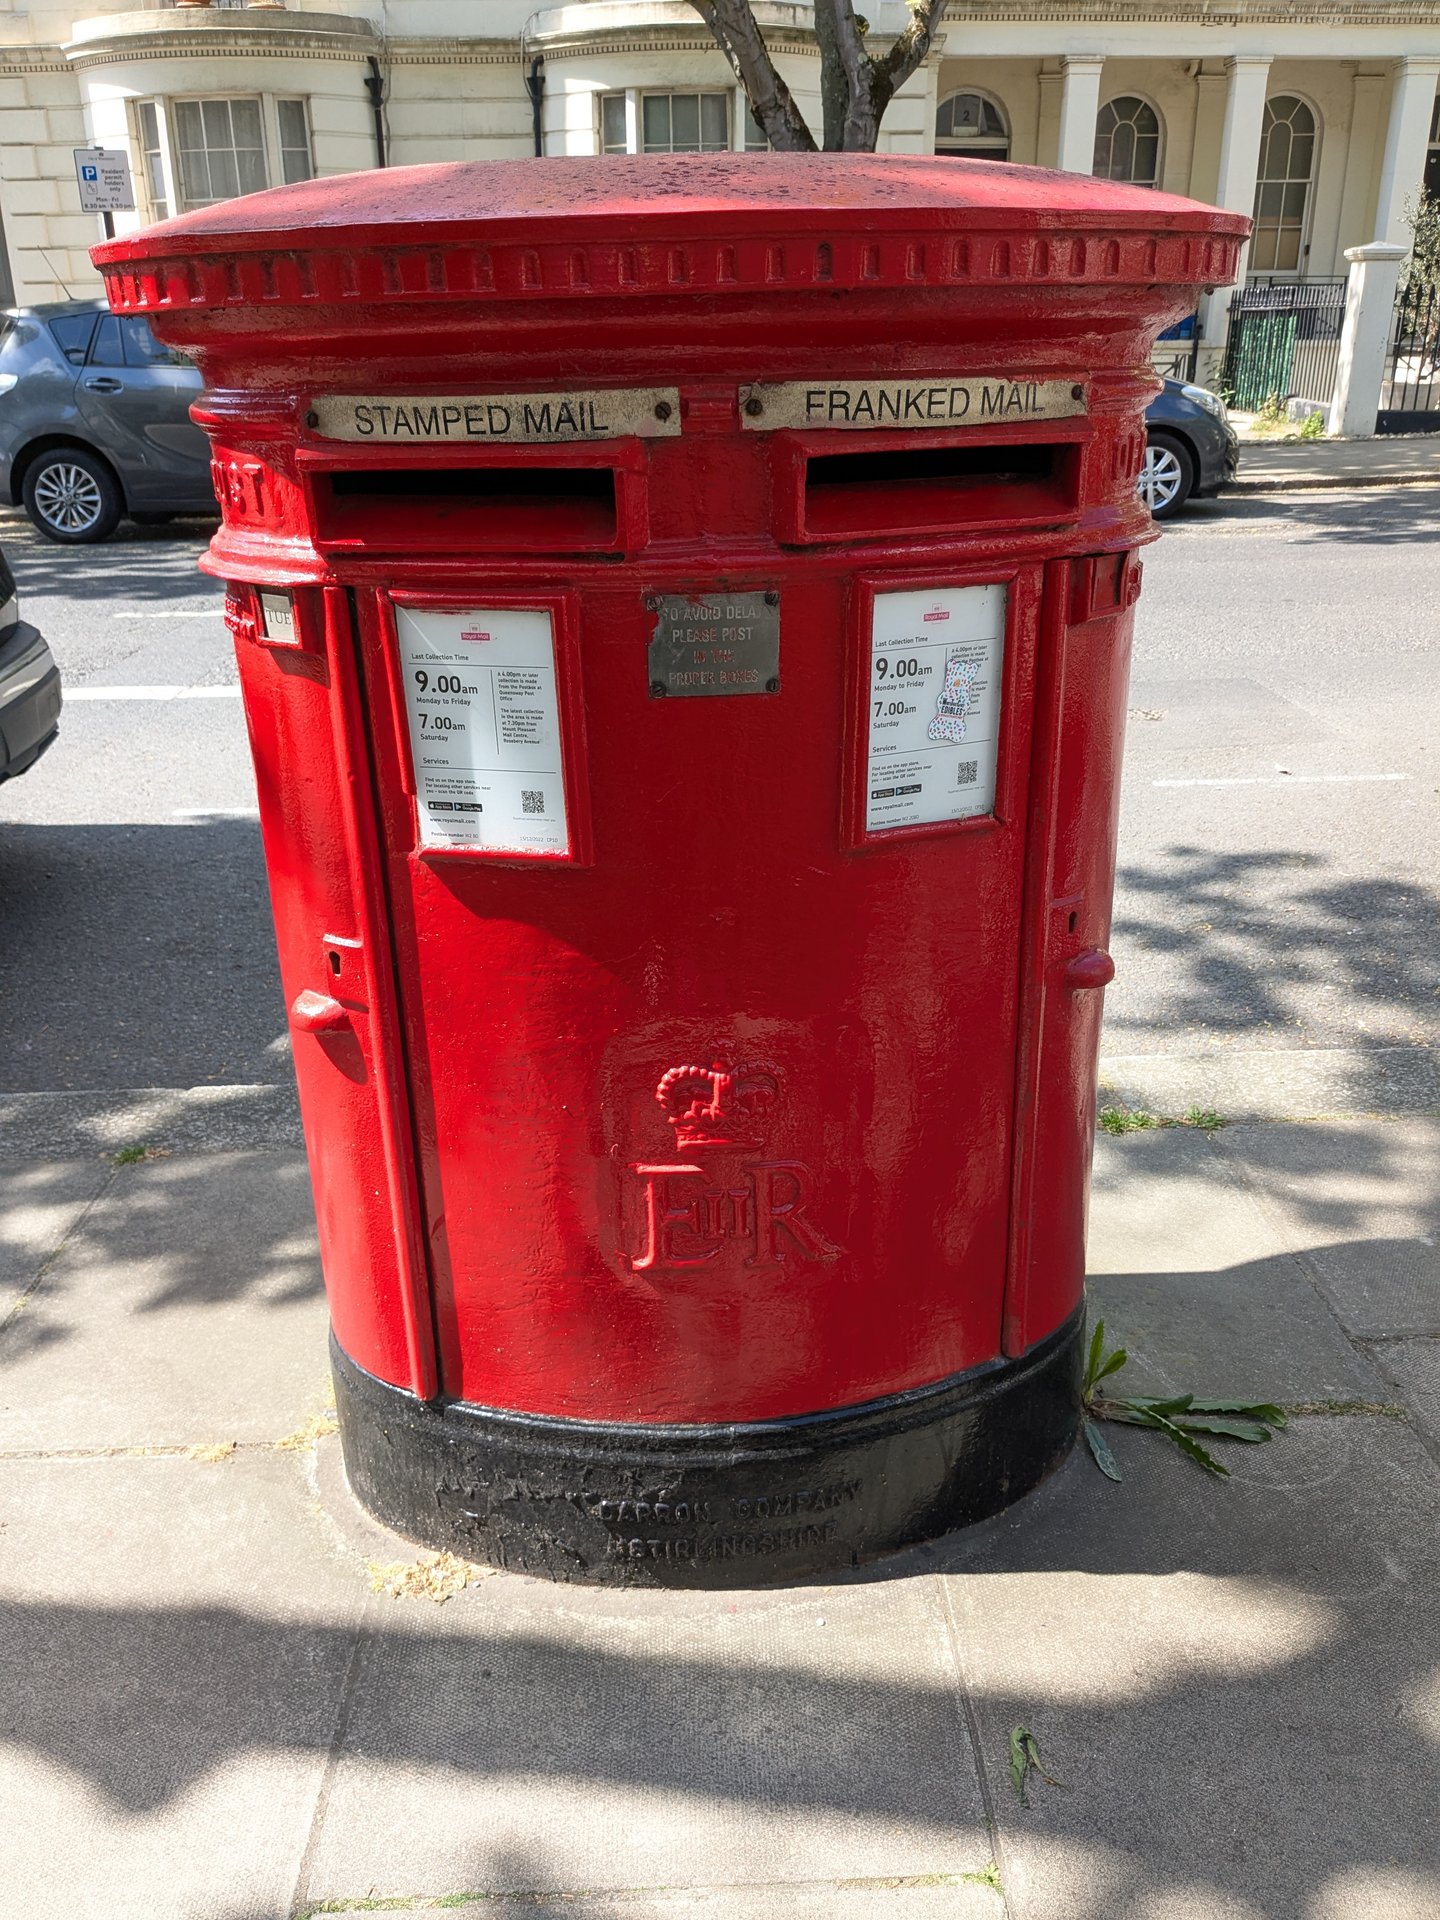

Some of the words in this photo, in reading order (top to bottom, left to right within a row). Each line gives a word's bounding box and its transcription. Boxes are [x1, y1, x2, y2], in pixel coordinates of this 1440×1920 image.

[963, 110, 970, 122] 2
[85, 168, 95, 180] P
[806, 387, 970, 422] FRANKED
[980, 384, 1046, 416] MAIL
[354, 404, 511, 436] STAMPED
[524, 402, 608, 434] MAIL
[266, 609, 292, 625] TUE
[684, 606, 720, 620] AVOID
[726, 606, 761, 620] DELA
[672, 628, 718, 642] PLEASE
[722, 627, 754, 642] POST
[876, 658, 932, 680] 9.00am
[415, 670, 478, 694] 9.00am
[668, 671, 716, 686] PROPER
[720, 669, 759, 684] BOXES
[874, 684, 897, 692] Monday
[416, 697, 441, 705] Monday
[451, 698, 471, 706] Friday
[874, 701, 916, 717] 7.00am
[941, 706, 962, 715] EDIBLES
[418, 713, 466, 730] 7.00am
[872, 720, 899, 729] Saturday
[420, 734, 448, 743] Saturday
[872, 745, 896, 753] Services
[871, 802, 913, 811] www.royalmail.com
[600, 1499, 710, 1522] CARRON
